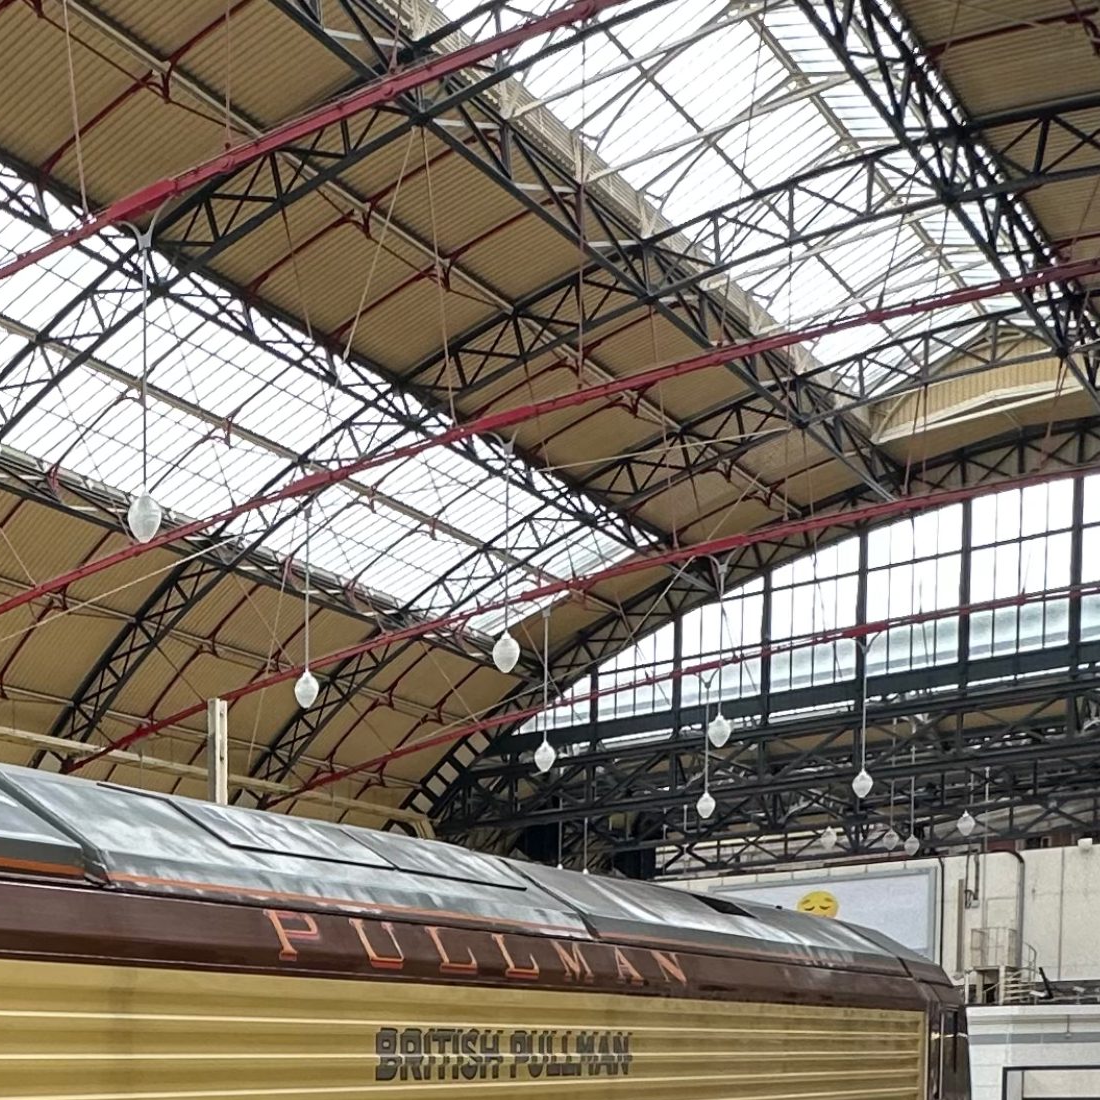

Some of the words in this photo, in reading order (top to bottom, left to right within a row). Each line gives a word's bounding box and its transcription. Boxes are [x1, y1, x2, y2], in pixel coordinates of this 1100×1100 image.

[262, 908, 688, 987] PULLMAN
[374, 1026, 504, 1081] BRITISH
[509, 1029, 634, 1078] PULLMAN
